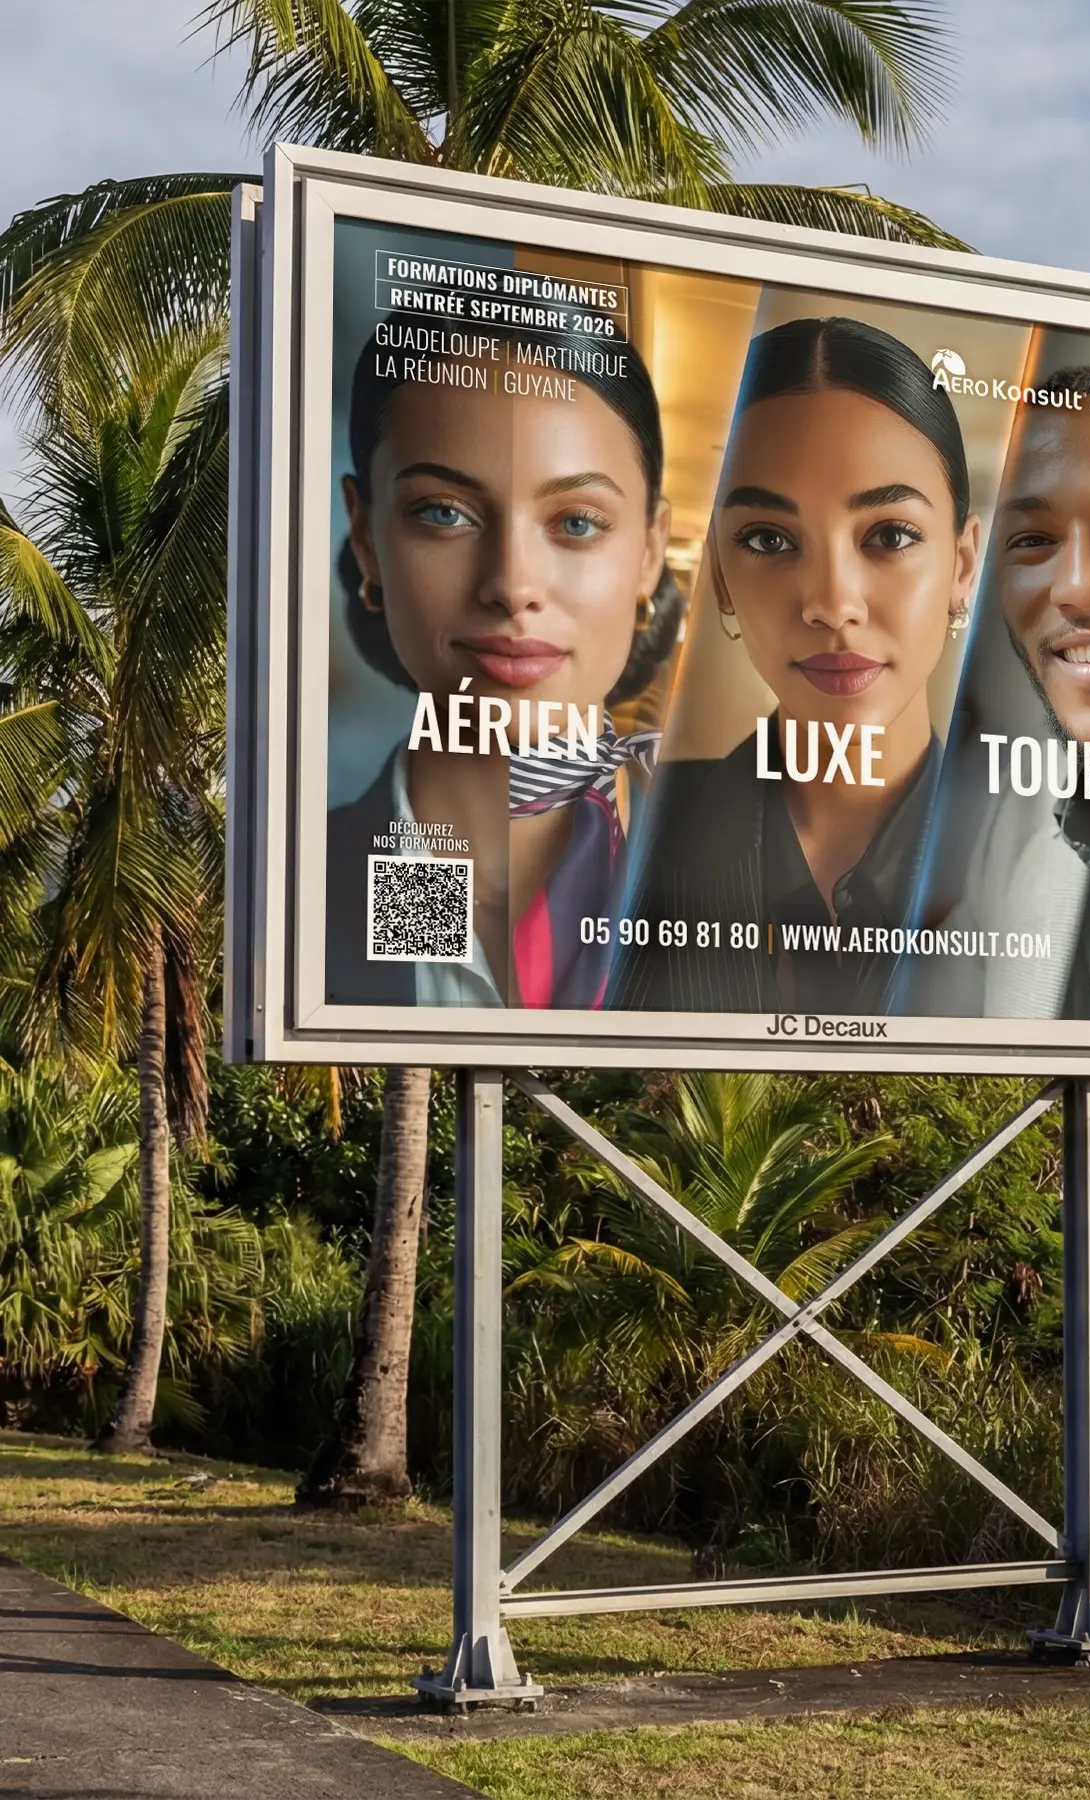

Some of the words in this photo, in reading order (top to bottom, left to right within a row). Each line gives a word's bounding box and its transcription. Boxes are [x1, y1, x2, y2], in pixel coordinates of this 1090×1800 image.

[388, 257, 498, 291] FORMATIONS
[503, 275, 618, 309] DIPLÔMANTES
[390, 288, 465, 316] RENTRÉE
[470, 299, 568, 329] SEPTEMBRE
[573, 314, 615, 337] 2026
[375, 322, 500, 361] GUADELOUPE
[517, 341, 628, 379] MARTINIQUE
[375, 354, 397, 379] LA
[404, 355, 487, 390] RÉUNION
[504, 371, 577, 402] GUYANE
[407, 677, 598, 762] AÉRIEN
[756, 716, 886, 787] LUXE
[389, 818, 454, 837] DÉCOUVREZ
[373, 835, 396, 850] NOS
[399, 836, 469, 852] FORMATIONS
[580, 917, 611, 946] 05
[619, 918, 650, 946] 90
[658, 919, 688, 947] 69
[697, 920, 720, 948] 81
[730, 922, 759, 949] 80
[782, 924, 1052, 959] WWW.AEROKONSULT.COM
[766, 1014, 798, 1036] JC
[804, 1015, 888, 1038] Decaux
